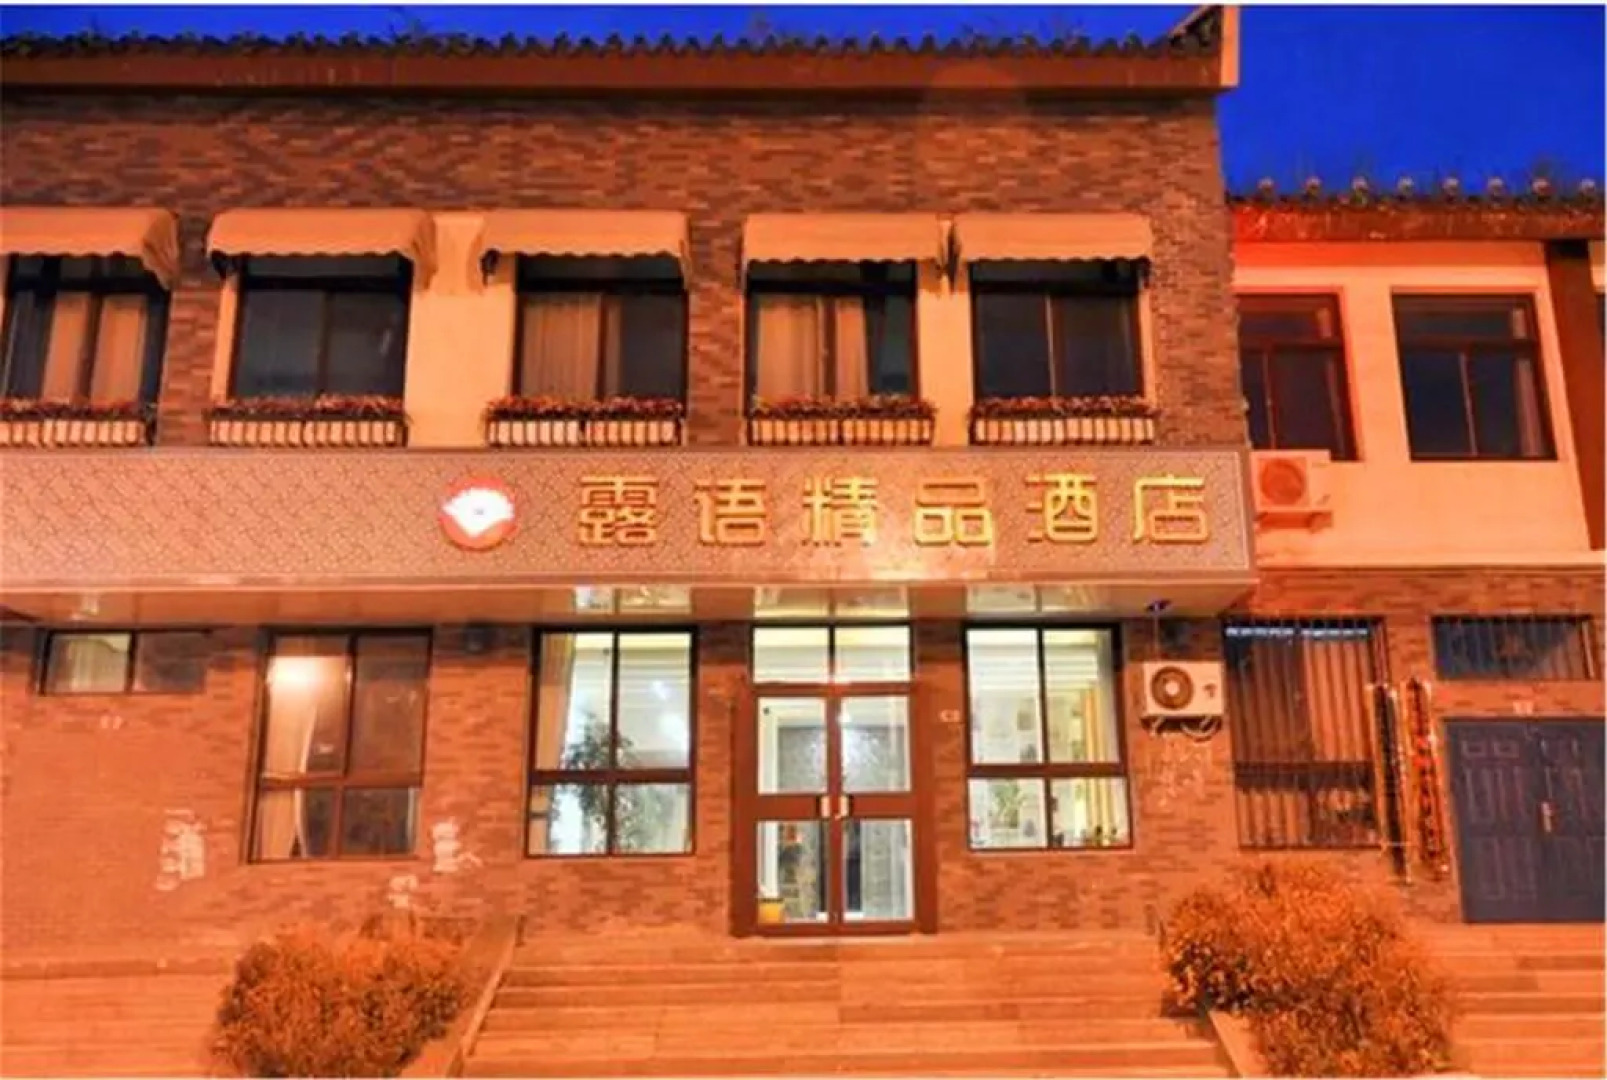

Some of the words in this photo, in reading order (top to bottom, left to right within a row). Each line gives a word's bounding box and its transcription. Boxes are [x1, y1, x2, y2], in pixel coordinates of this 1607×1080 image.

[578, 472, 1210, 547] 露语精品酒店
